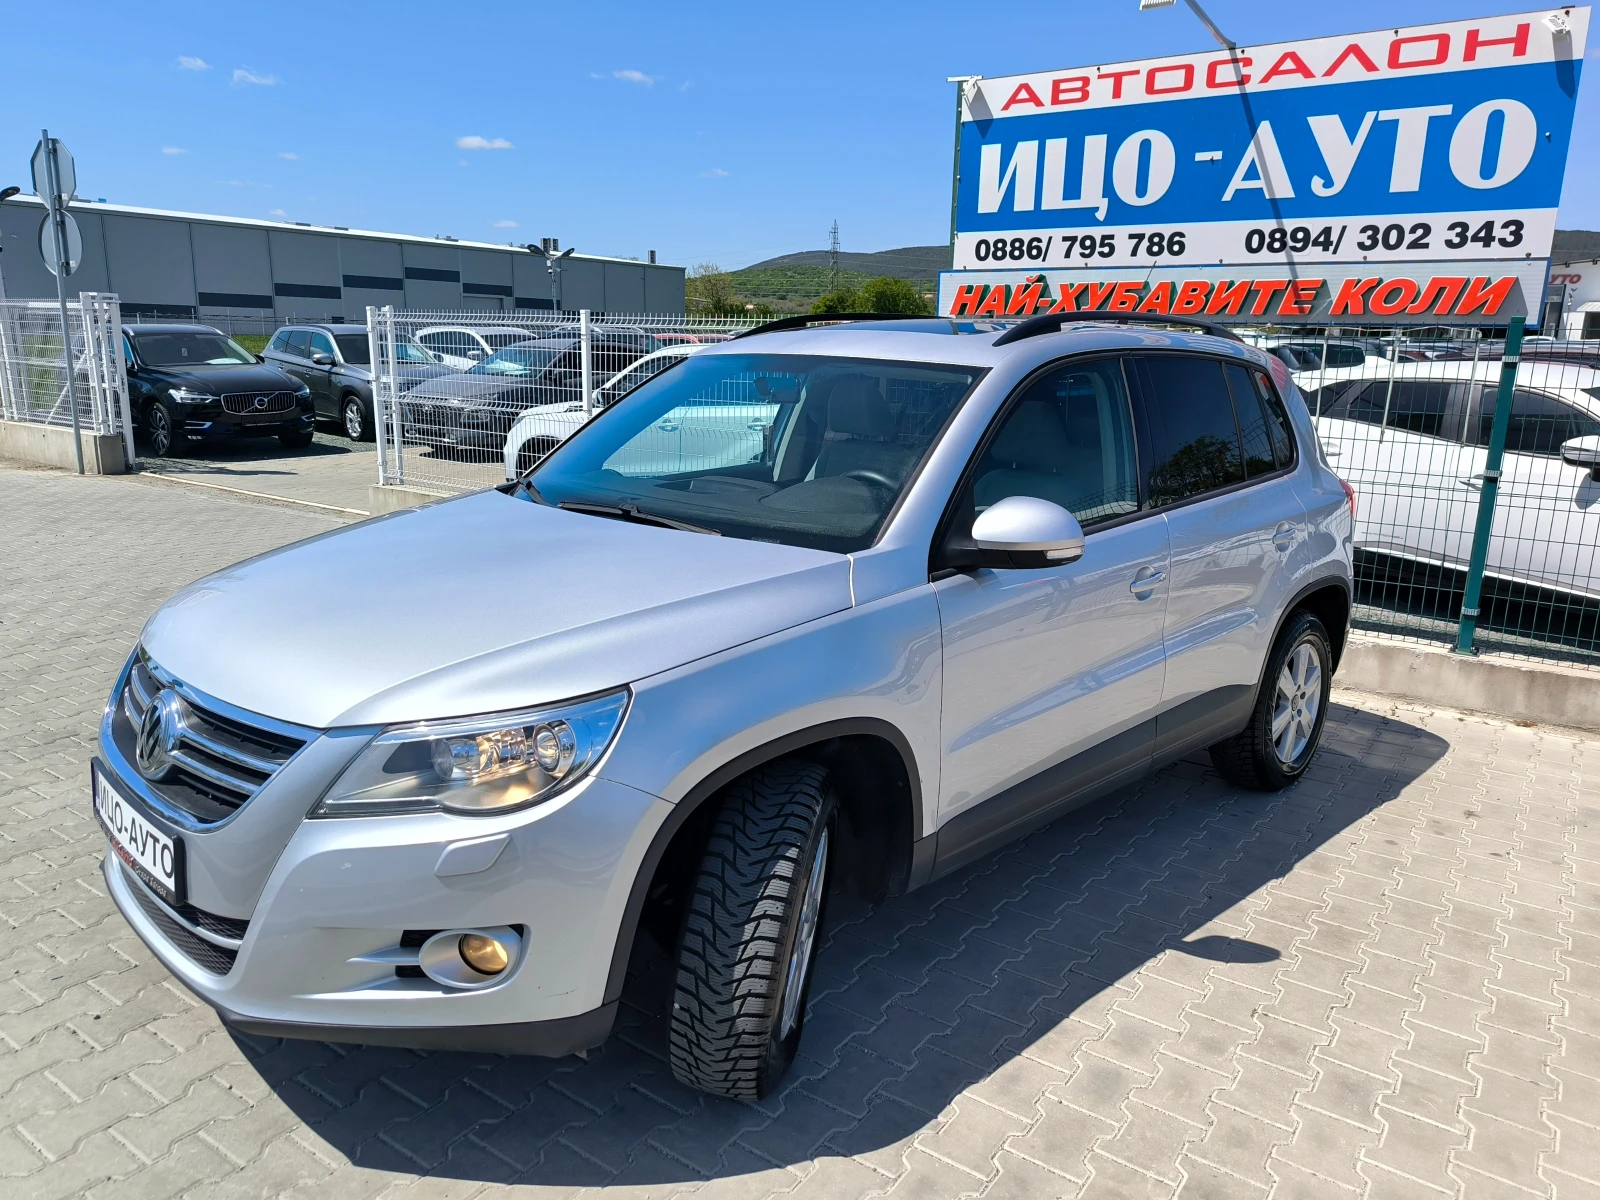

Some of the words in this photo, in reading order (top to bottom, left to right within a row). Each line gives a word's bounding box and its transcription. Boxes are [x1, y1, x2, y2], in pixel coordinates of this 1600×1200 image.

[1001, 22, 1532, 111] АВТОСАЛОН
[974, 235, 1053, 263] 0886/
[1061, 234, 1116, 260] 795
[1127, 231, 1186, 257] 786
[1244, 225, 1348, 255] 0894/
[1356, 222, 1432, 252] 302
[1444, 219, 1525, 250] 343
[949, 273, 1323, 316] НАЙ-ХУБАВИТЕ
[1329, 276, 1517, 316] КОЛИ
[98, 780, 175, 880] ИЦО-АУТО
